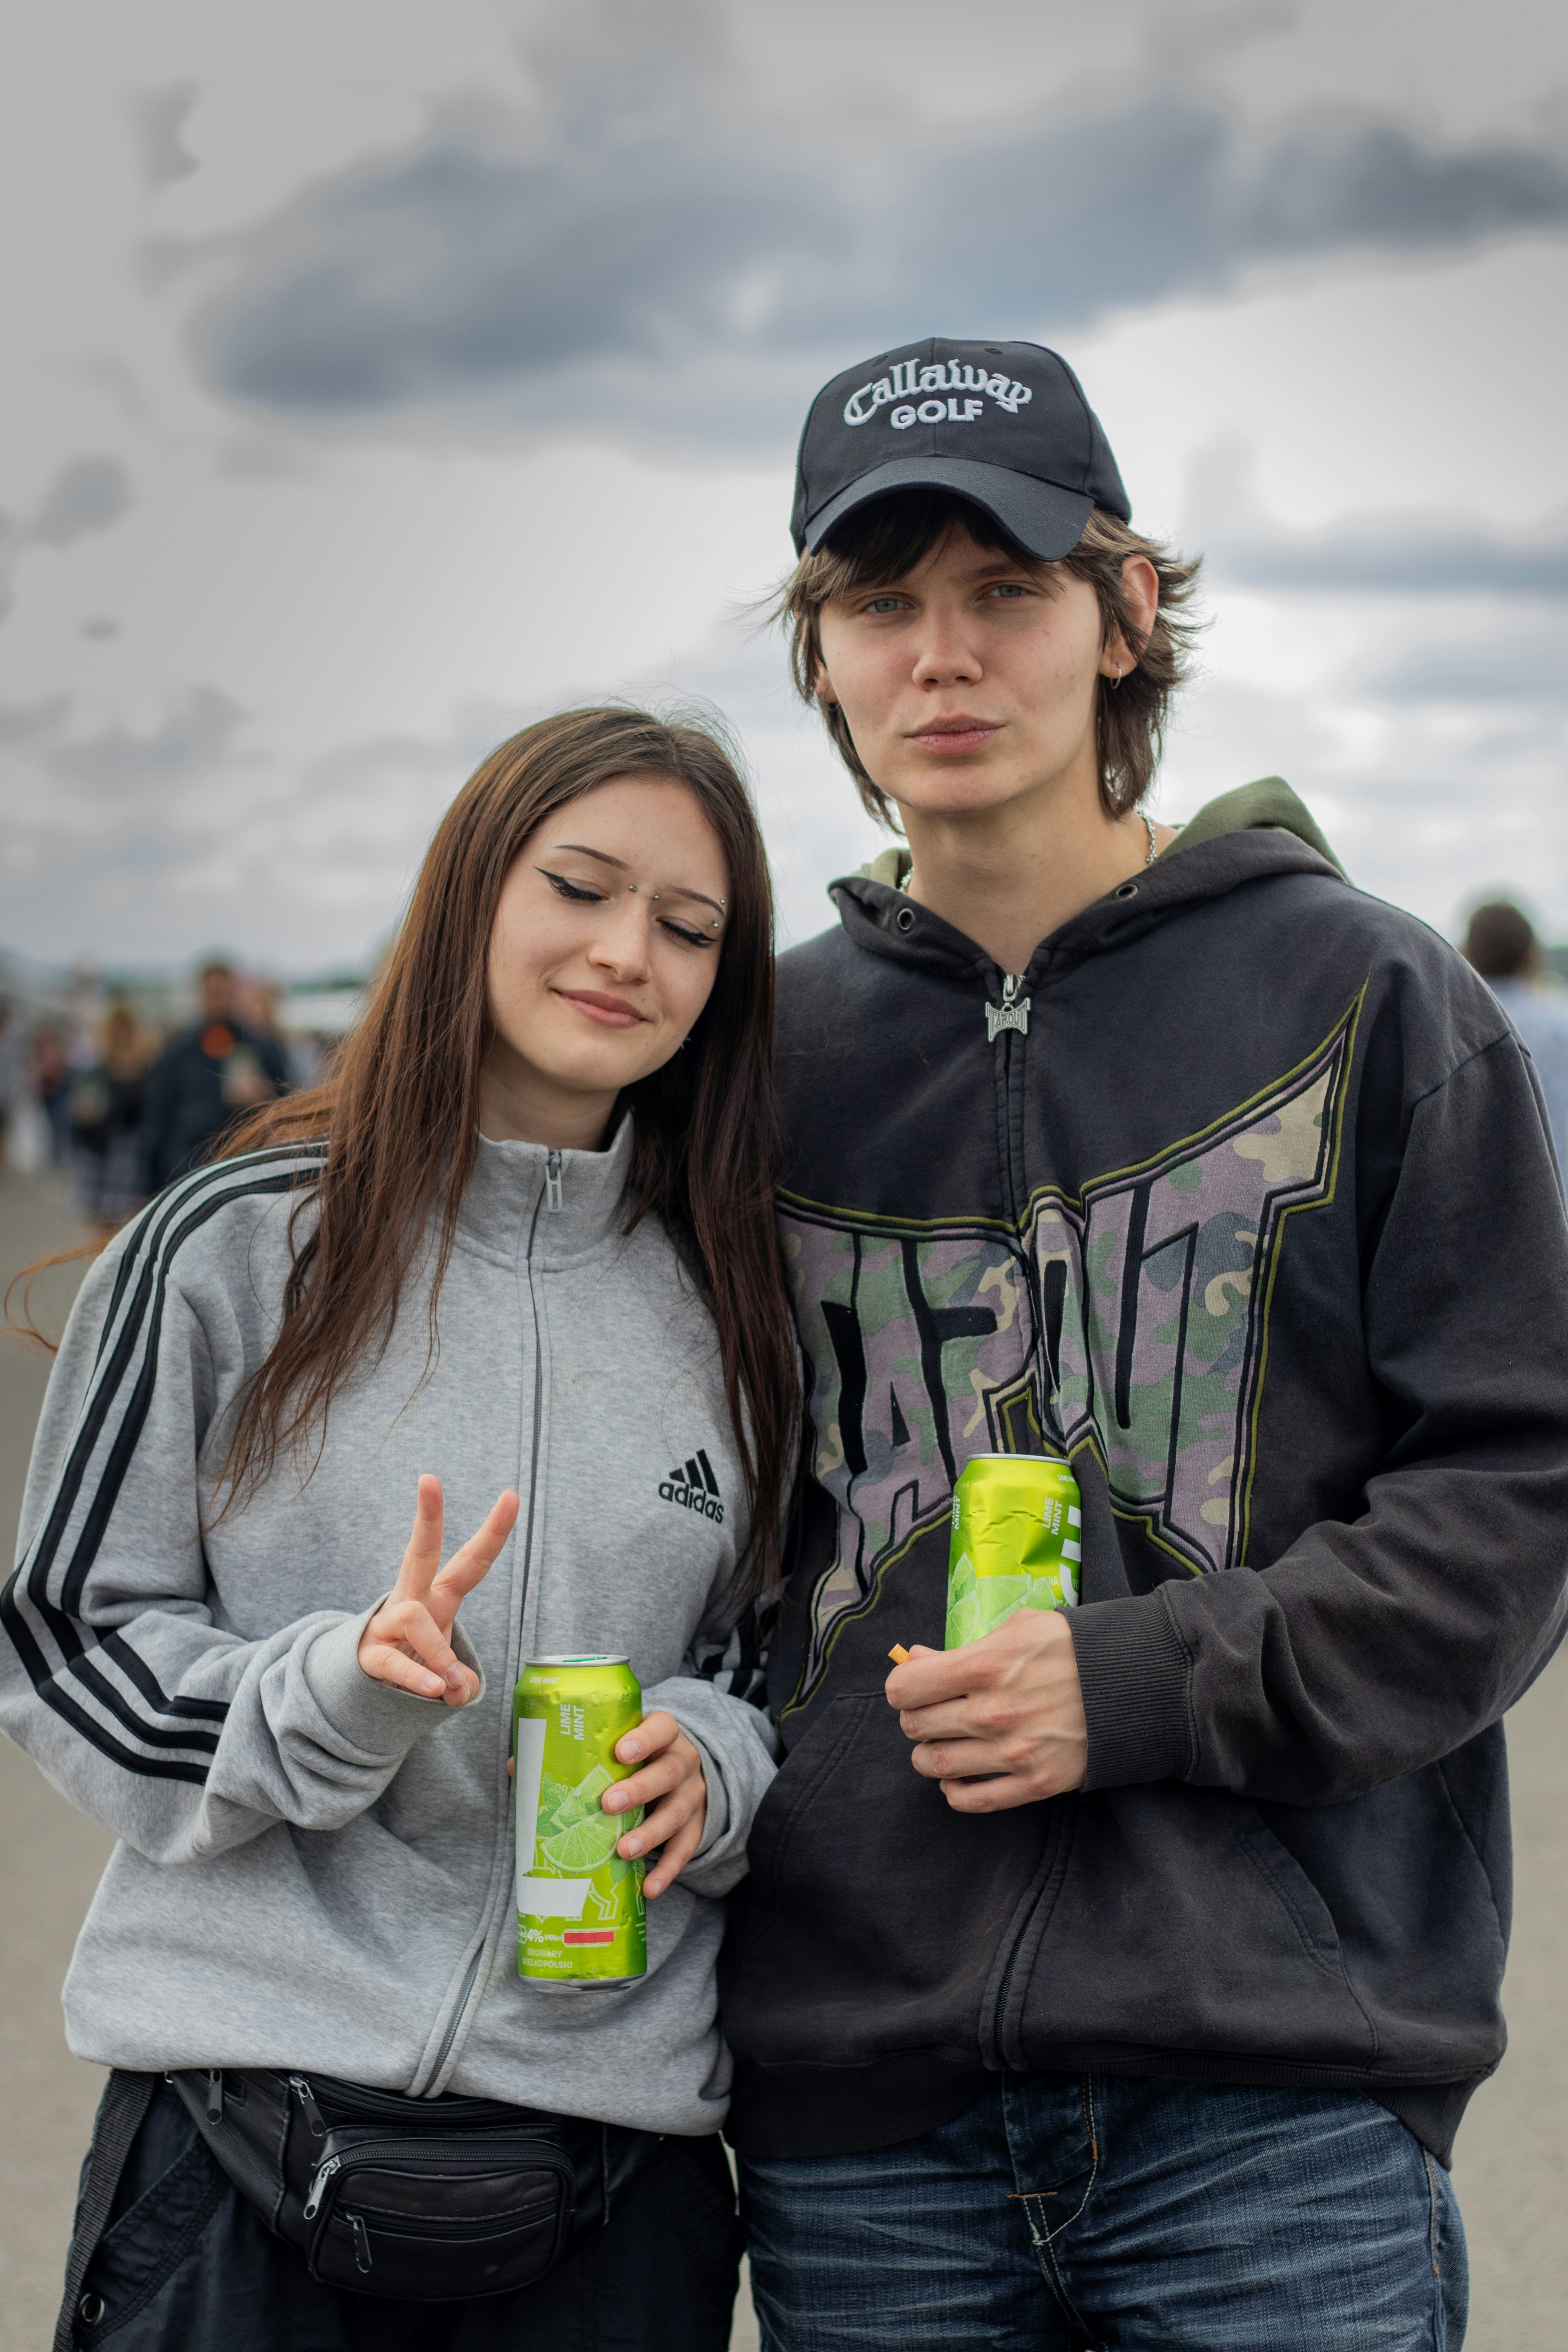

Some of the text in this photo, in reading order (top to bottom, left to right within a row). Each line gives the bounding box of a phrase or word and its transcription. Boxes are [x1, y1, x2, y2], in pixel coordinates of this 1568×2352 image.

[844, 358, 1032, 426] Callaway
[891, 398, 983, 429] GOLF
[985, 998, 1030, 1042] TAPOUT
[658, 1482, 724, 1524] adidas
[1043, 1497, 1053, 1528] LIME
[1051, 1500, 1062, 1535] MINT
[560, 1703, 571, 1735] LIME
[573, 1705, 584, 1740] MINT
[527, 1929, 544, 1943] 4%
[522, 1958, 573, 1969] WIELKOPOLSKI
[527, 1948, 563, 1958] BROWARY
